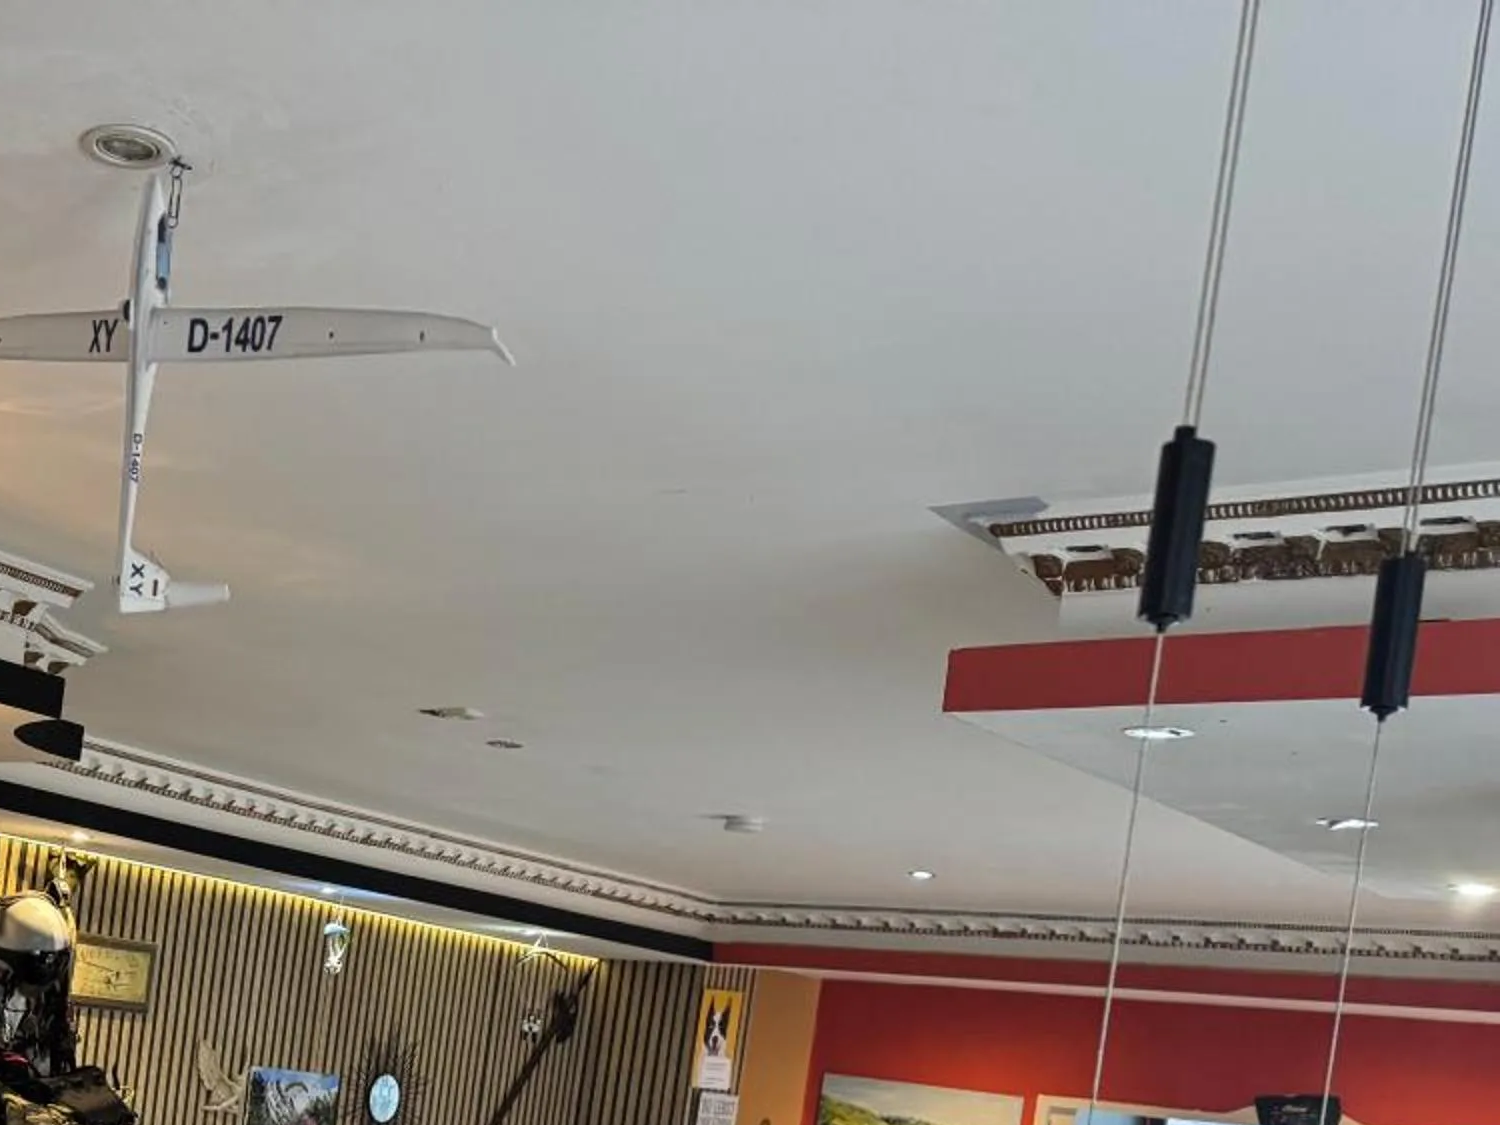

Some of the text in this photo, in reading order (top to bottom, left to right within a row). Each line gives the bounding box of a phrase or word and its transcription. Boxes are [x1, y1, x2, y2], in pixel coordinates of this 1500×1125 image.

[89, 319, 118, 352] XY
[187, 315, 282, 353] D-1407
[130, 563, 145, 596] XY
